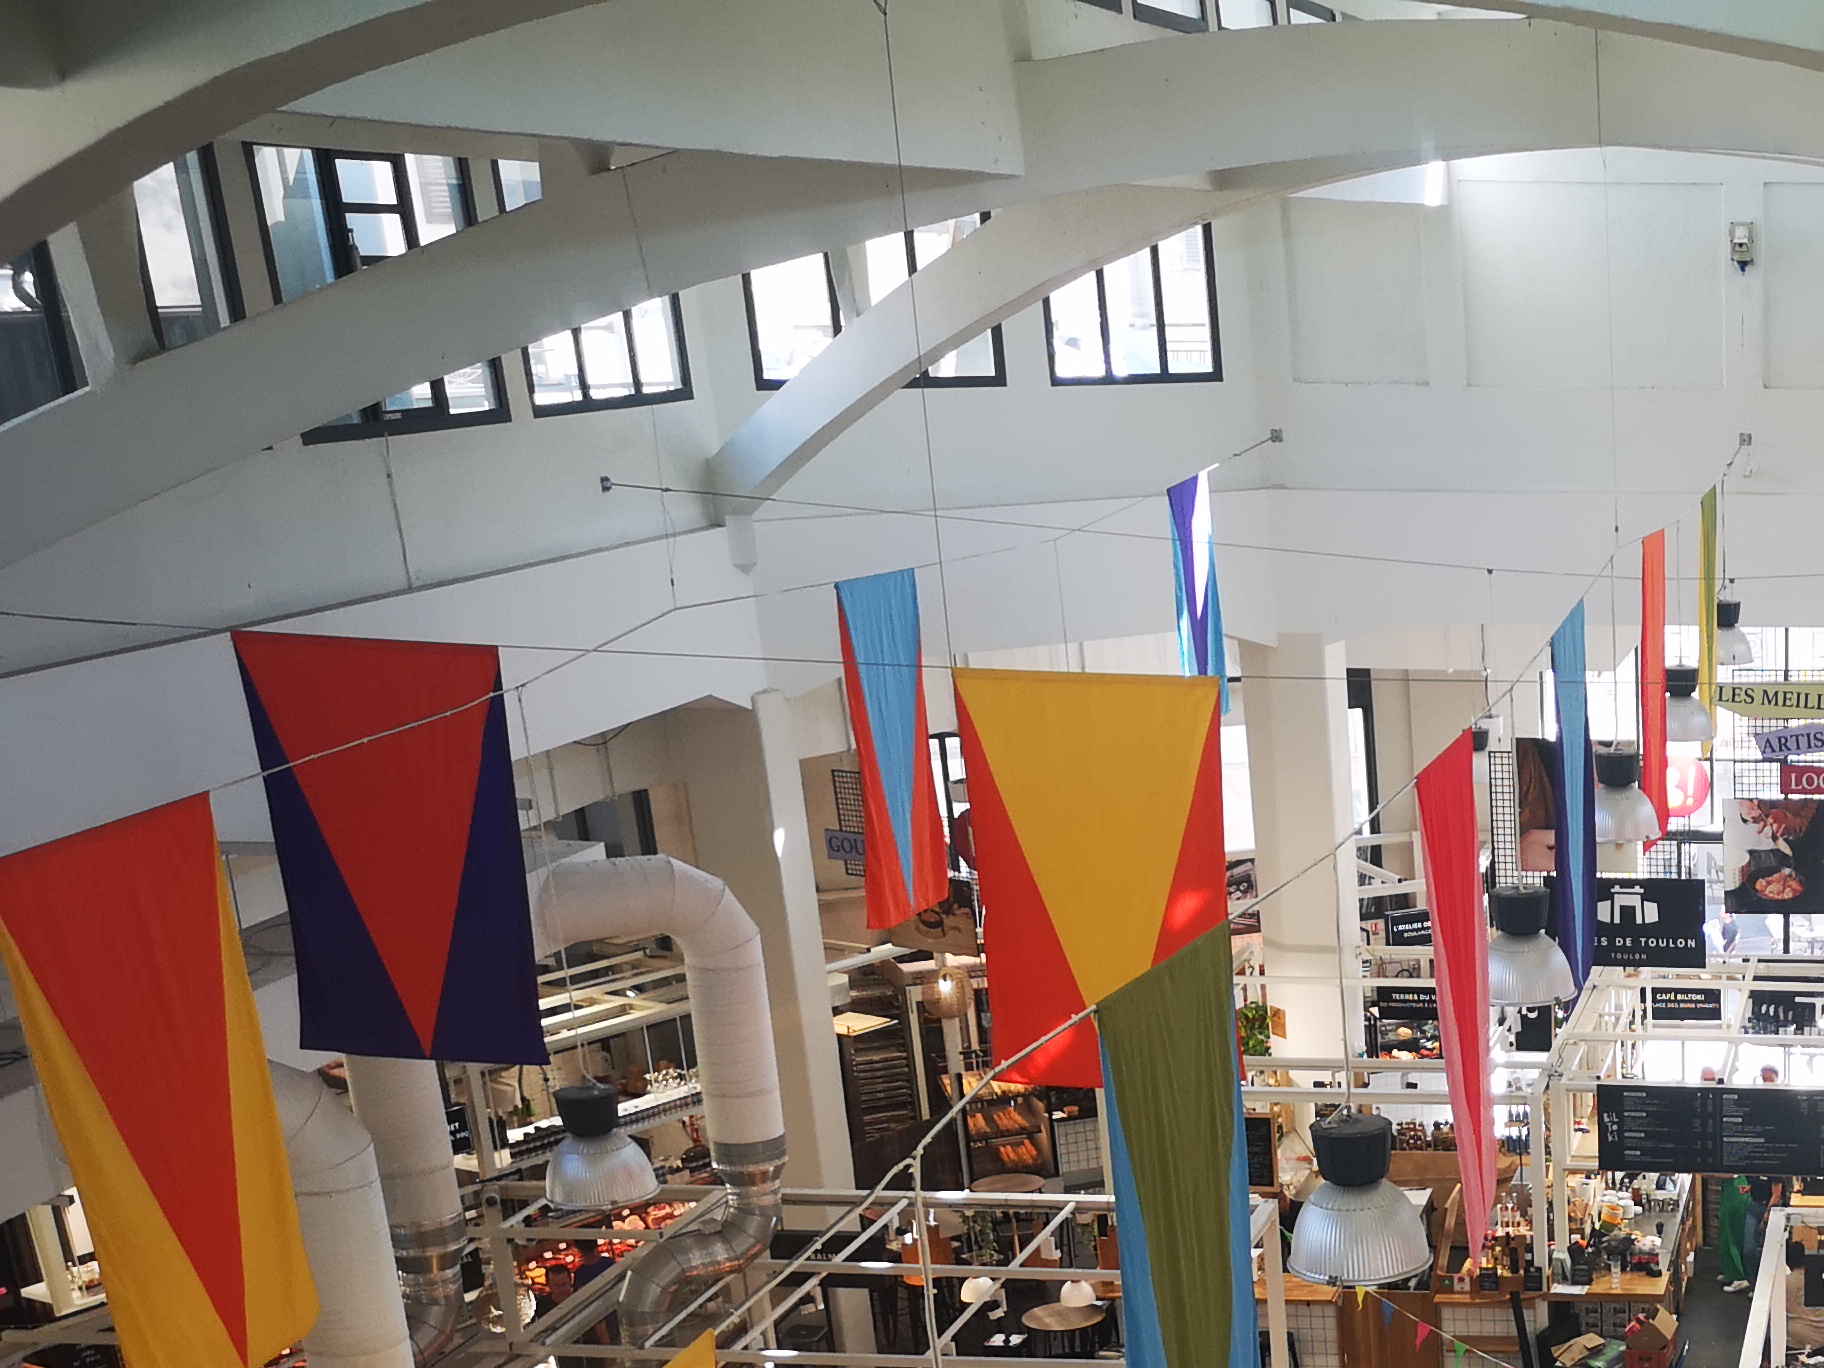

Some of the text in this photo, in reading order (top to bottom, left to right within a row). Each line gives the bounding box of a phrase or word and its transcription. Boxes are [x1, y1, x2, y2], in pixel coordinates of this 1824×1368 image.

[1717, 686, 1755, 704] LES
[829, 836, 865, 856] GOU
[1616, 937, 1632, 947] DE
[1640, 937, 1696, 948] TOULON
